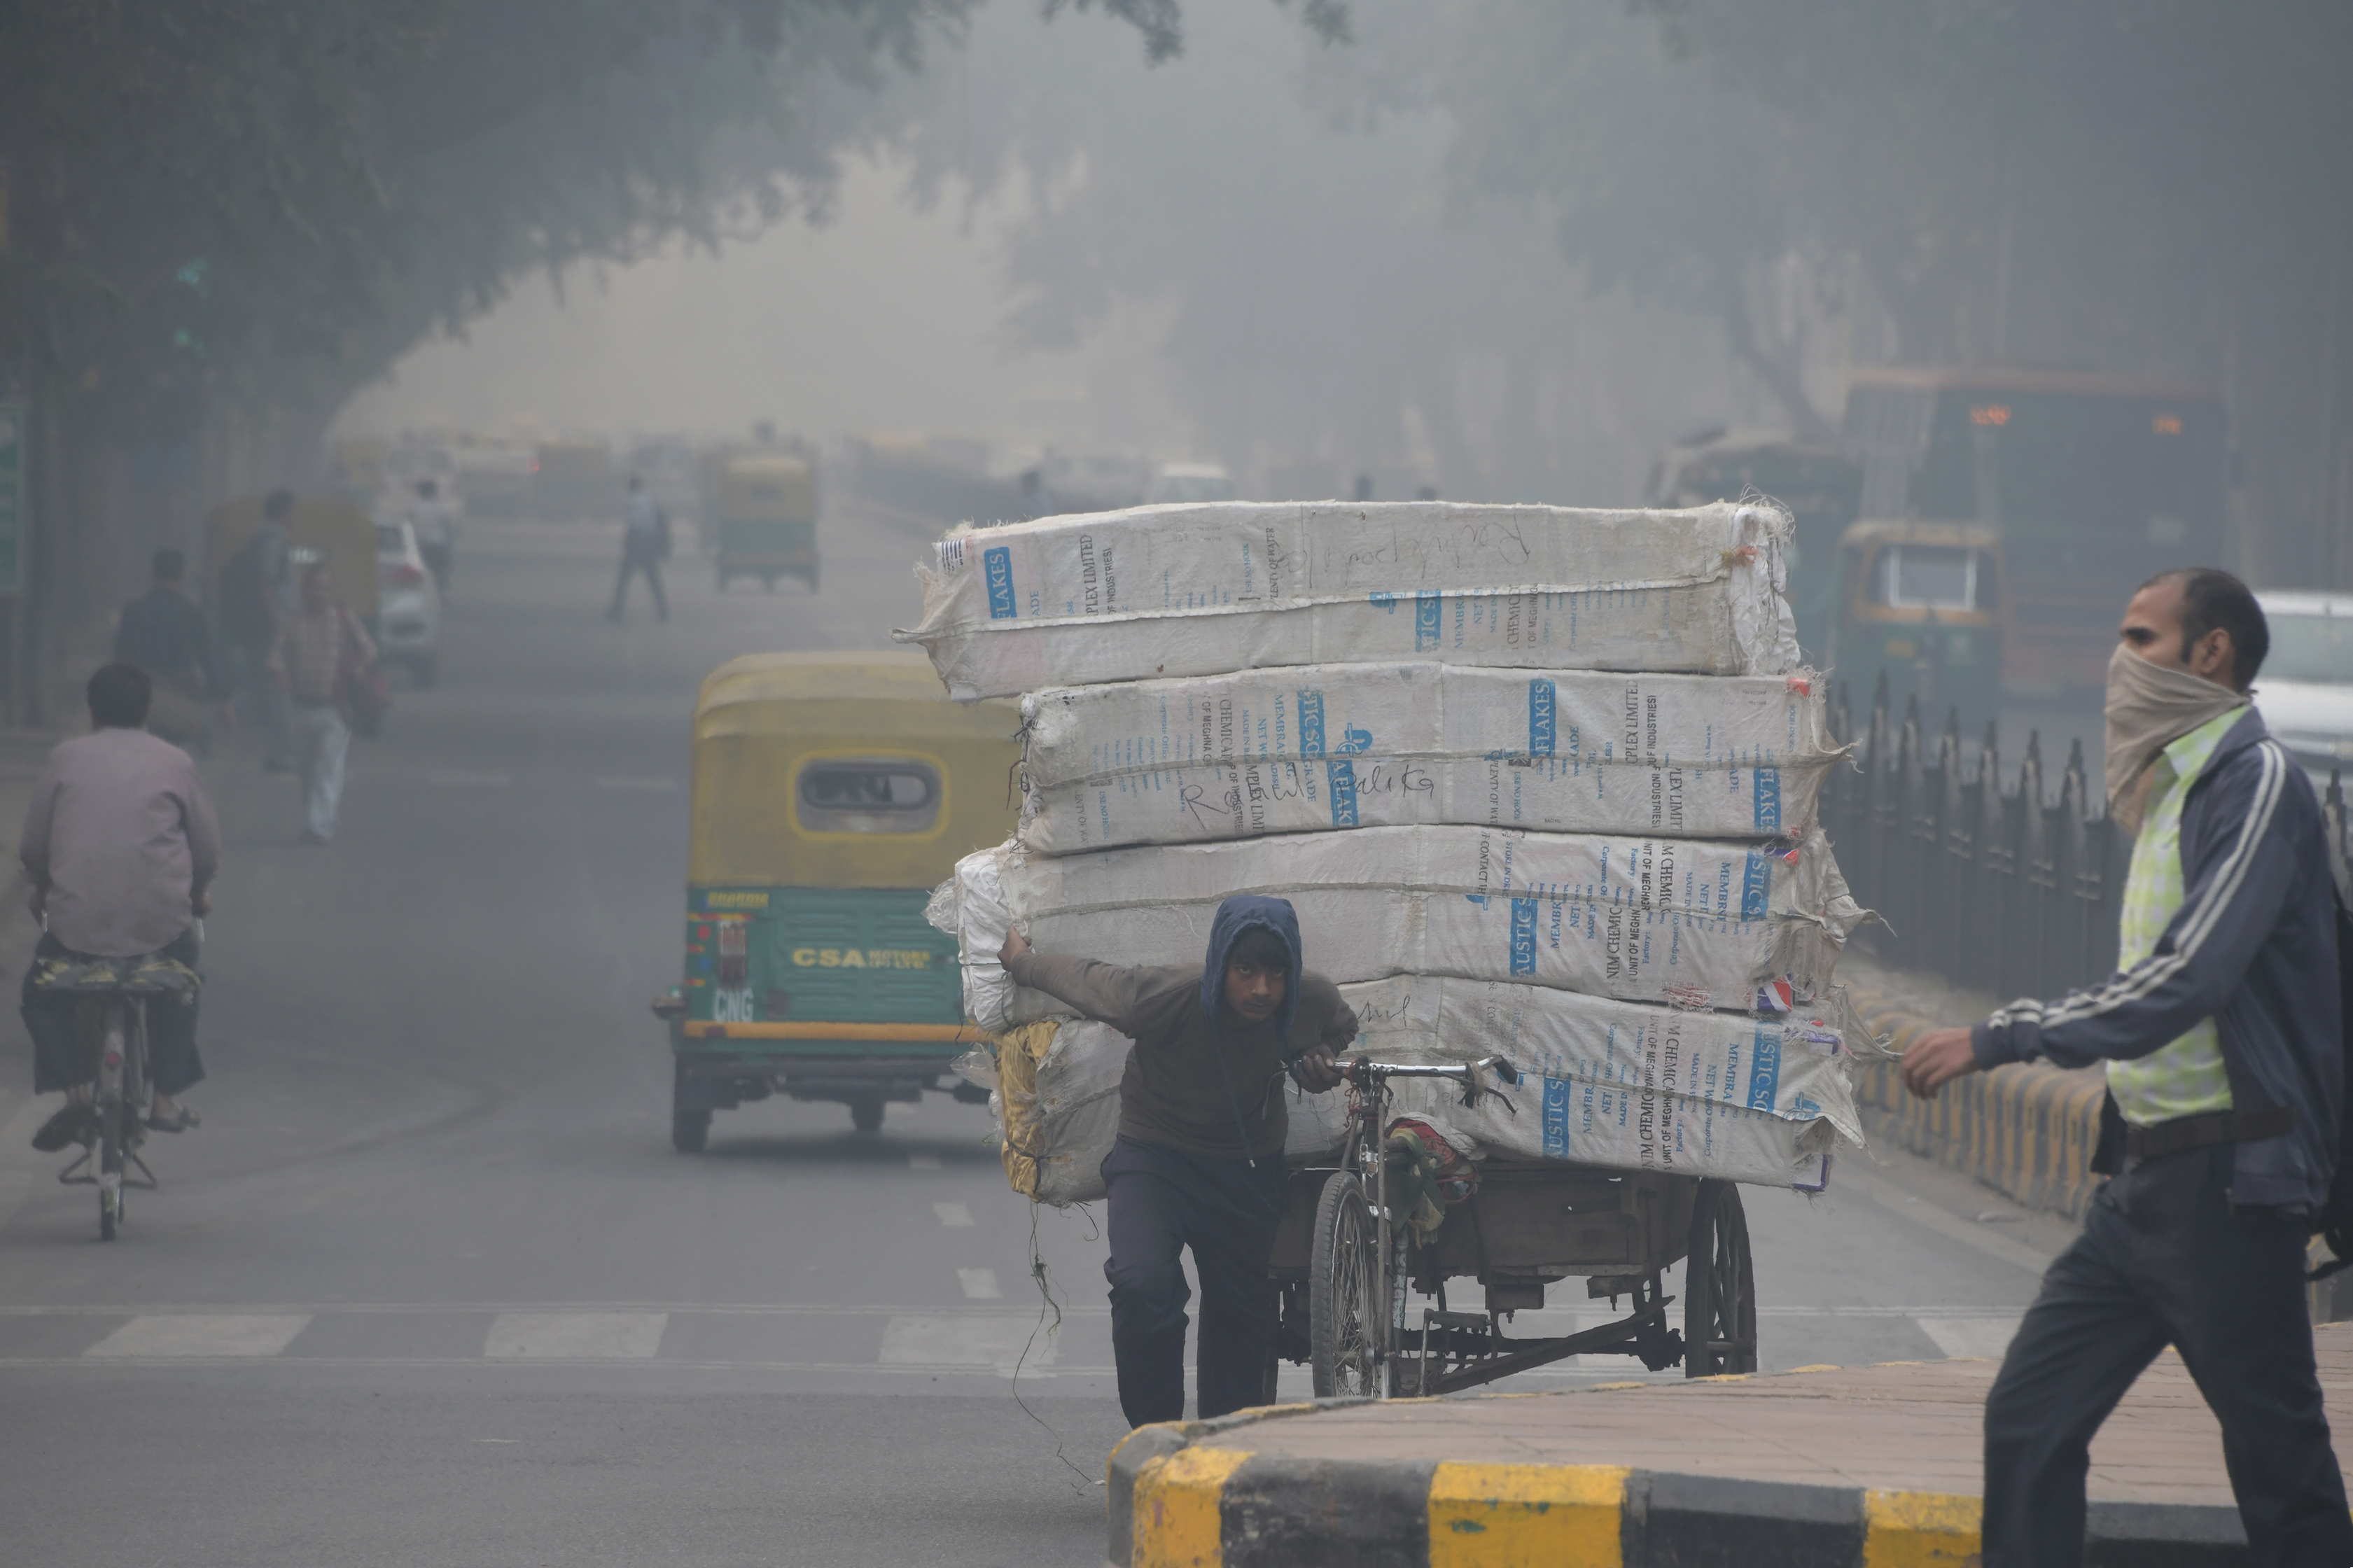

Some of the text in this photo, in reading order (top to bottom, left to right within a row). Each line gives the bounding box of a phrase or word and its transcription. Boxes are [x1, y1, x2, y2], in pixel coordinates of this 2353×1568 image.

[1080, 535, 1096, 583] LIMITED
[1242, 543, 1251, 565] HOOK
[1265, 527, 1279, 599] LENTY OF WATER
[1244, 566, 1252, 578] NO
[1474, 603, 1483, 624] NET
[1490, 598, 1497, 606] IN
[1528, 631, 1536, 642] OF
[1626, 680, 1638, 728] LIMITED
[1202, 701, 1211, 751] OF MEGHNA
[1275, 694, 1285, 753] MEMBRA
[1535, 683, 1550, 750] FLAKES
[1647, 694, 1656, 749] INDUSTRIES)
[1257, 718, 1266, 739] NET
[1789, 727, 1794, 738] NO
[1244, 736, 1250, 745] IN
[1229, 773, 1238, 783] OF
[1304, 760, 1316, 802] GRADE
[1489, 760, 1499, 792] PLENTY
[1490, 794, 1498, 805] OF
[1514, 786, 1521, 797] NO
[1652, 774, 1661, 828] INDUSTRIES)
[1075, 792, 1085, 815] ENTY
[1101, 805, 1108, 816] NO
[1077, 817, 1087, 827] OF
[1479, 841, 1489, 882] CONTACT
[1504, 867, 1511, 875] IN
[1600, 846, 1610, 883] Corporate
[1628, 848, 1638, 880] Factory:
[1642, 858, 1652, 869] OF
[1699, 883, 1710, 906] NET
[1569, 906, 1581, 927] NET
[1607, 907, 1622, 953] CHEMIC
[793, 948, 867, 967] CSA
[1628, 943, 1638, 954] OF
[1642, 932, 1652, 964] Factory:
[1670, 927, 1679, 965] Corporate
[1628, 956, 1638, 975] UNIT
[715, 989, 754, 1023] CNG
[1606, 1023, 1617, 1060] Corporate
[1633, 1026, 1645, 1058] Factory:
[1647, 1037, 1658, 1049] OF
[1756, 1032, 1775, 1086] USTIC
[1689, 1053, 1700, 1090] MADE IN
[1706, 1064, 1717, 1087] NET
[1602, 1092, 1612, 1114] NET
[1619, 1100, 1627, 1126] MADE
[1661, 1129, 1671, 1142] OF
[1676, 1119, 1684, 1152] Factory:
[1704, 1117, 1712, 1156] Corporate
[1663, 1144, 1672, 1163] UNIT
